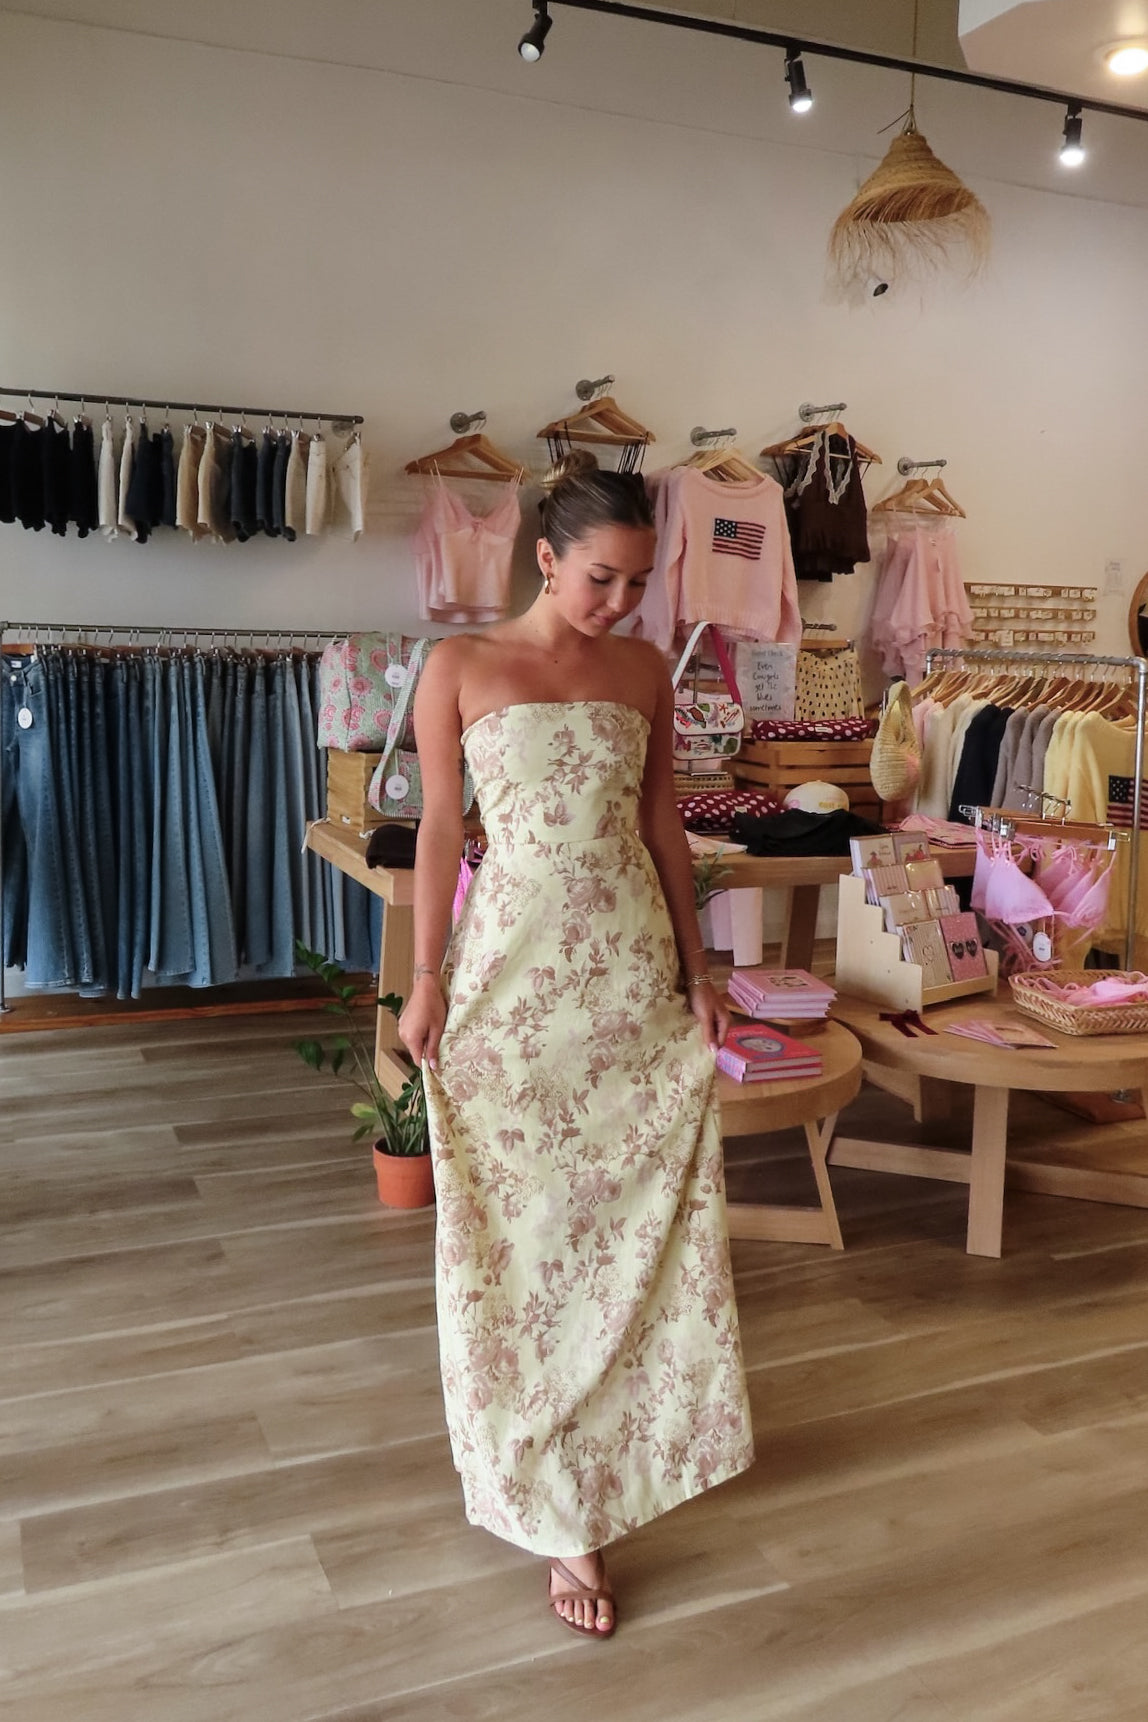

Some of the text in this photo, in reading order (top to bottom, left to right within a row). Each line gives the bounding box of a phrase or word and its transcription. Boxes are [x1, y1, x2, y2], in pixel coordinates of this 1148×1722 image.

[757, 661, 773, 670] Even
[755, 683, 764, 693] get
[749, 704, 782, 712] sometimes
